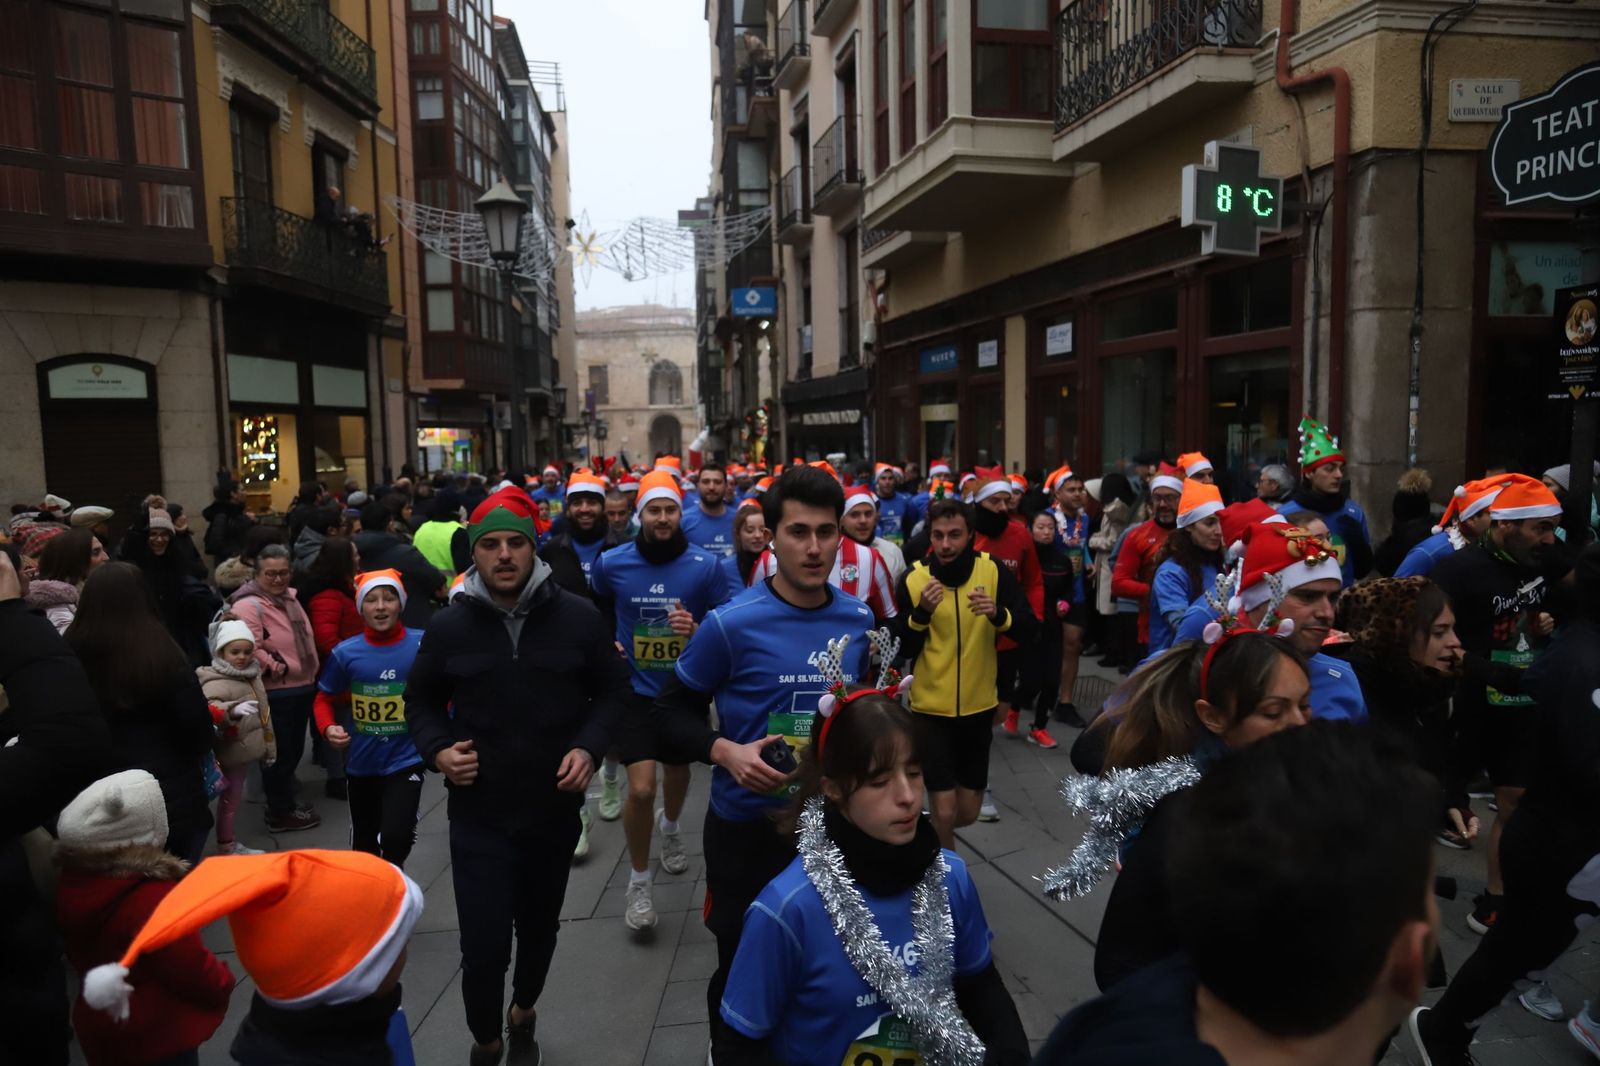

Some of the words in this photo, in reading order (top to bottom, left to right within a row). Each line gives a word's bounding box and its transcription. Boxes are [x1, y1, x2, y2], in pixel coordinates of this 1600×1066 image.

[1474, 85, 1504, 94] CALLE
[1479, 96, 1492, 105] DE
[1217, 184, 1232, 212] 8
[1535, 255, 1552, 268] Un
[1562, 271, 1578, 285] de
[648, 583, 665, 594] 46
[637, 640, 680, 660] 786
[807, 651, 829, 668] 46
[380, 669, 396, 680] 46
[779, 674, 795, 683] SAN
[355, 700, 398, 722] 582
[856, 993, 877, 1008] SAN
